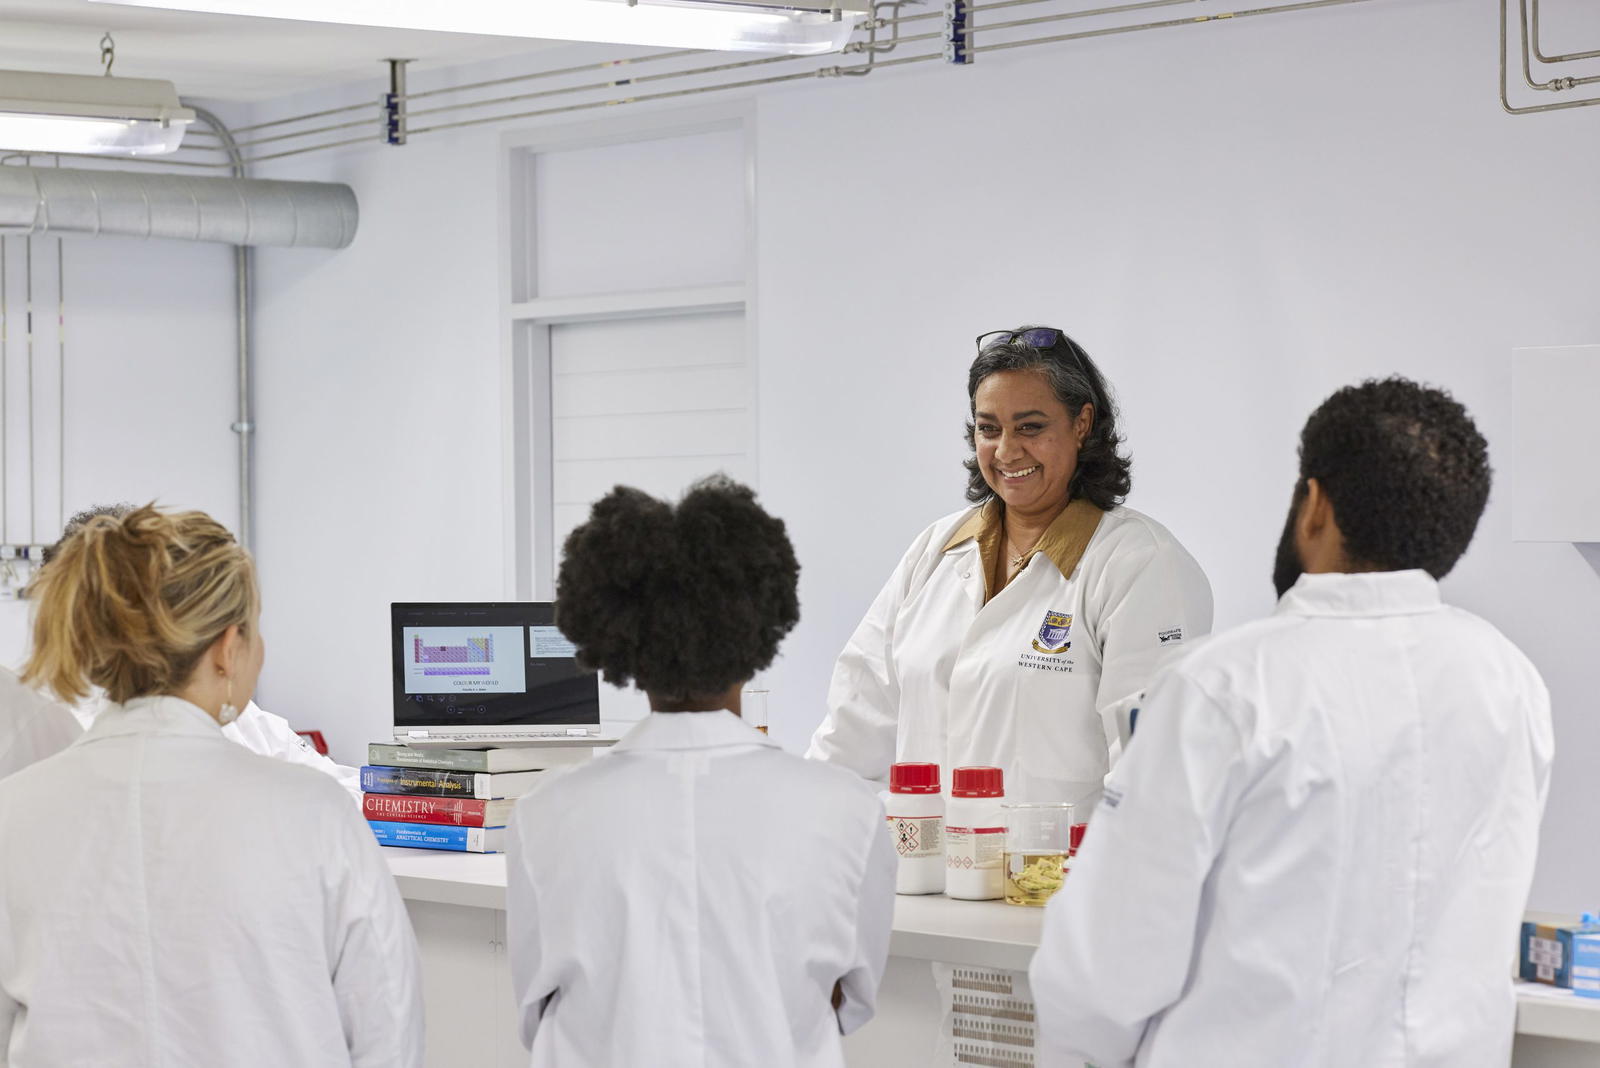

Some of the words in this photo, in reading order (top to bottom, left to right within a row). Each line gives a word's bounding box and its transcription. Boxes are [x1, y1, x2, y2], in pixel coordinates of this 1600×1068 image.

[1020, 654, 1060, 663] UNIVERSITY
[1018, 661, 1052, 670] WESTERN
[400, 778, 436, 788] Instrumental
[438, 779, 462, 790] Analysis
[366, 798, 436, 814] CHEMISTRY
